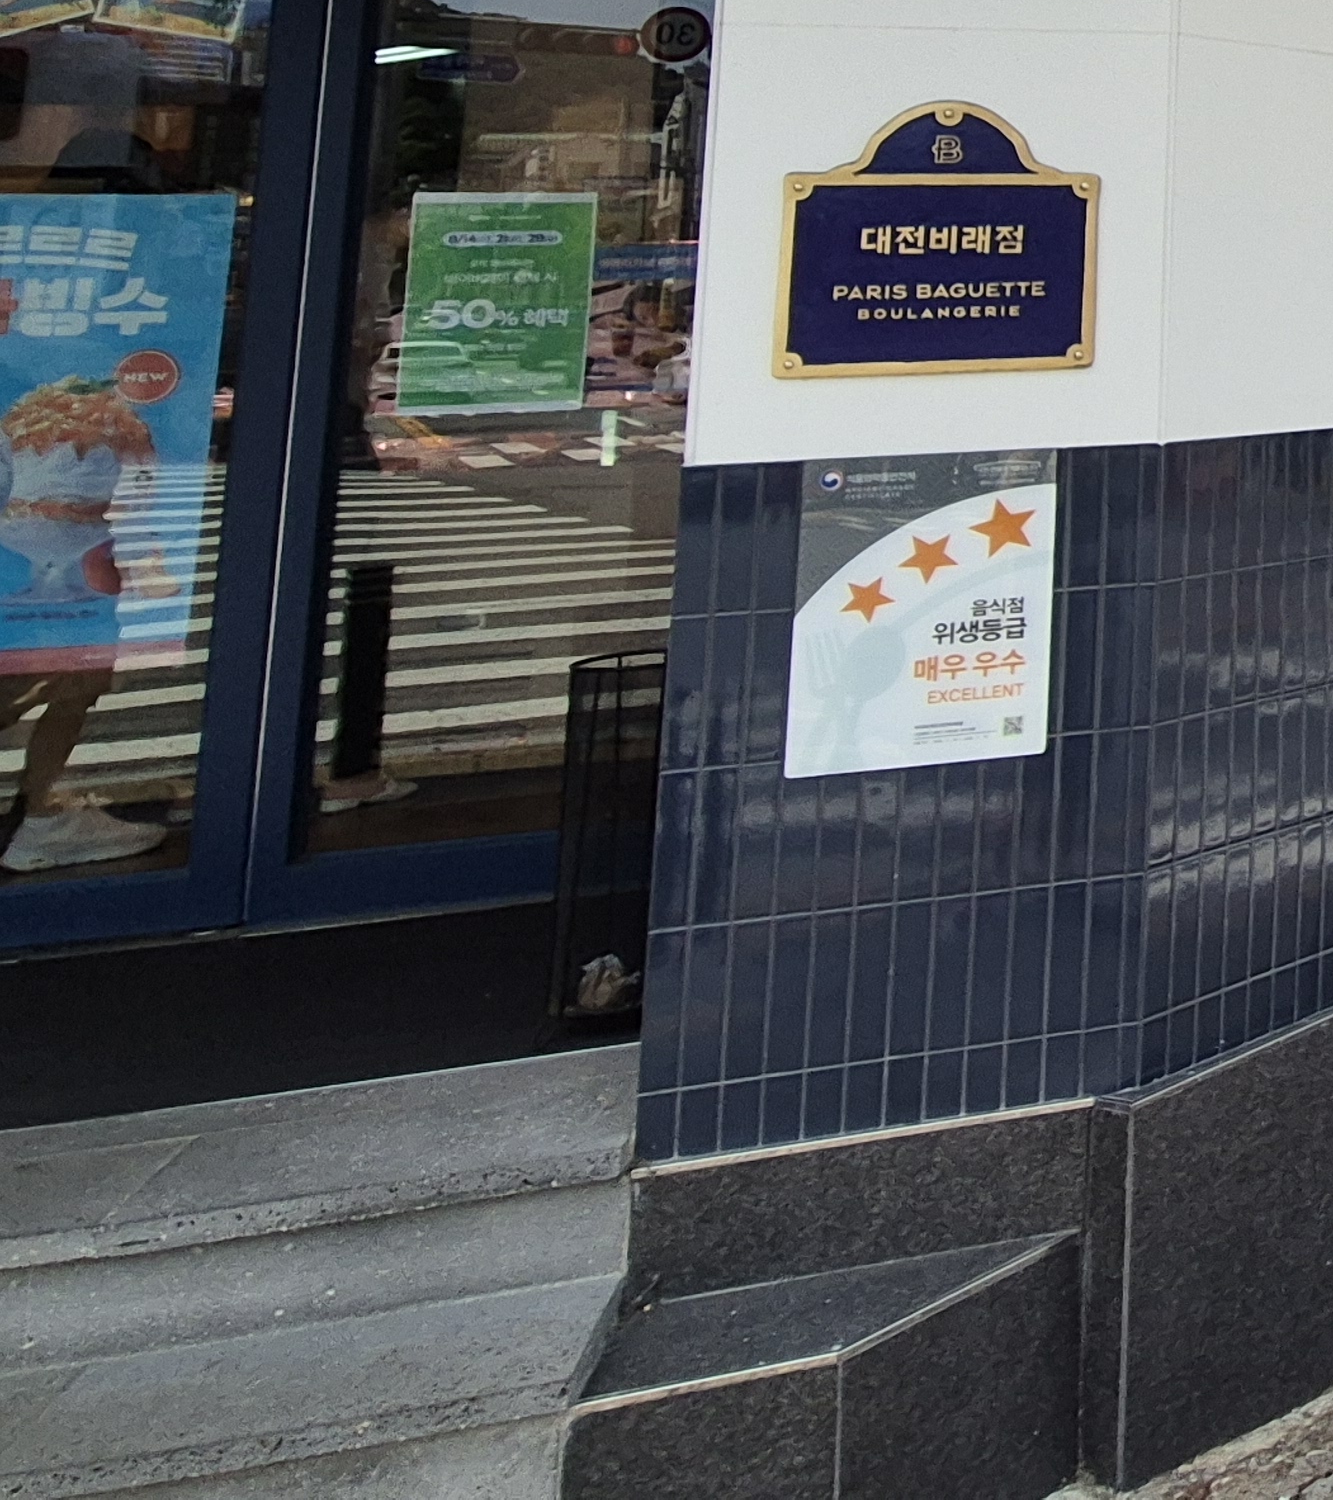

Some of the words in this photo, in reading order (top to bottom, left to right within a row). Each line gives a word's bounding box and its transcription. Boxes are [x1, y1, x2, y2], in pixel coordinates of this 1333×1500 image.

[860, 224, 1024, 255] 대전비래점
[832, 283, 908, 301] PARIS
[915, 281, 1046, 300] BAGUETTE
[857, 305, 1021, 320] BOULANGERIE
[123, 371, 169, 383] NEW
[971, 596, 1025, 617] 음식점
[932, 617, 1027, 645] 위생등급
[913, 654, 967, 682] 매우
[972, 649, 1026, 678] 우수
[927, 682, 1025, 705] EXCELLENT
